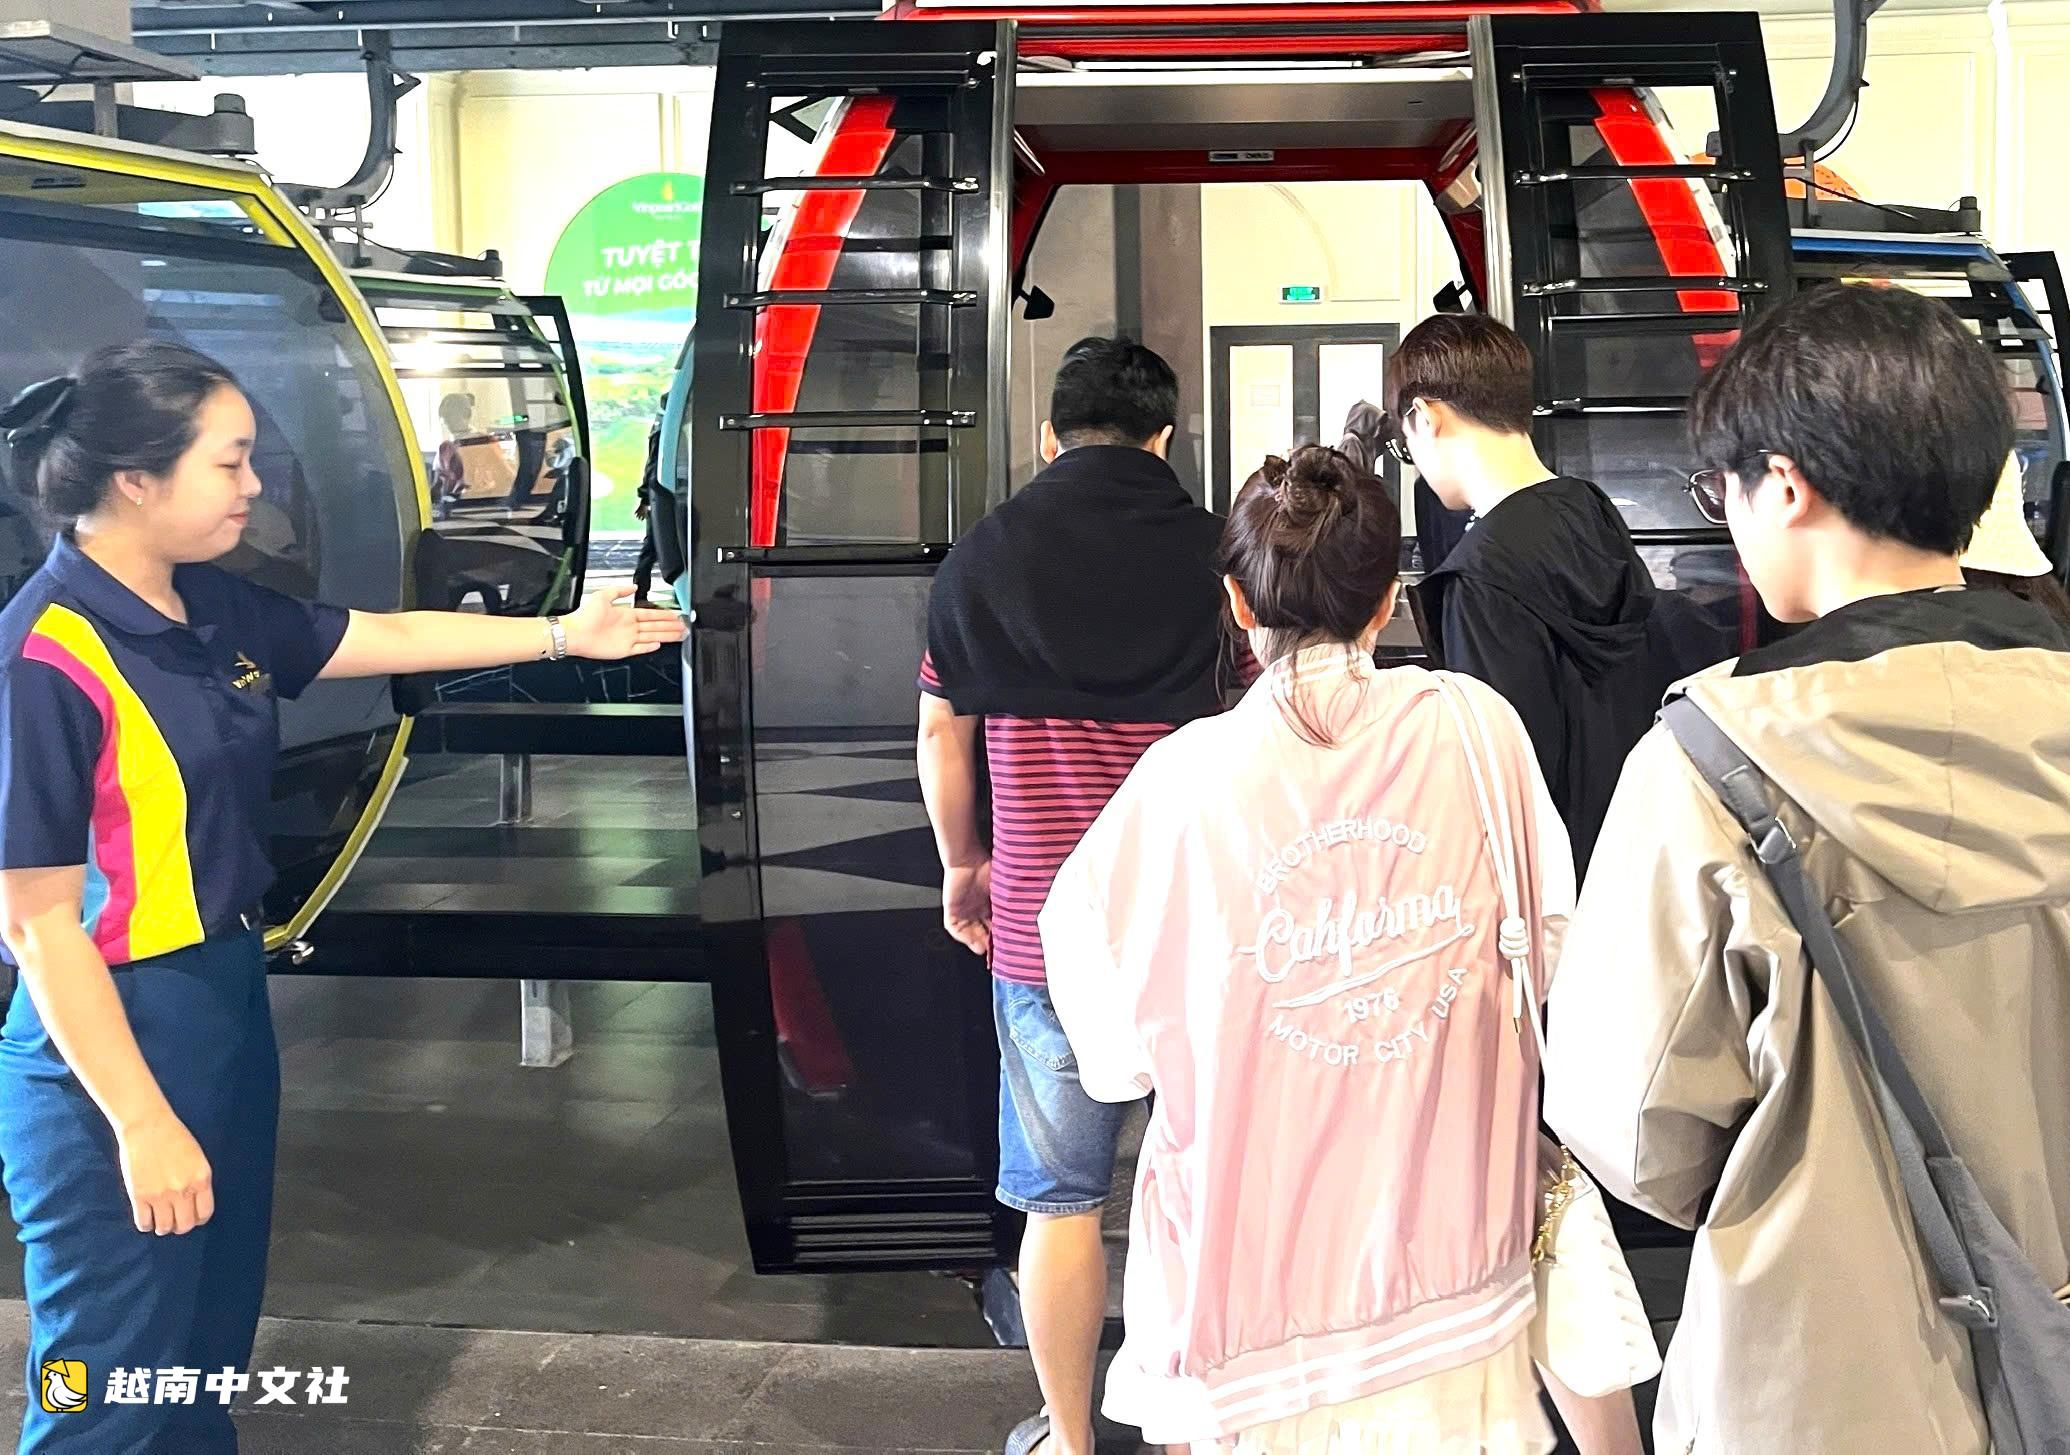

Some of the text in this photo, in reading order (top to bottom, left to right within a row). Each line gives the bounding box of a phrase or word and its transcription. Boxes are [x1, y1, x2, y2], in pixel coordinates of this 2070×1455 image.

[601, 239, 681, 268] TUYỆT
[1256, 818, 1426, 895] BROTHERHOOD
[1269, 967, 1468, 1066] MOTOR CITY USA
